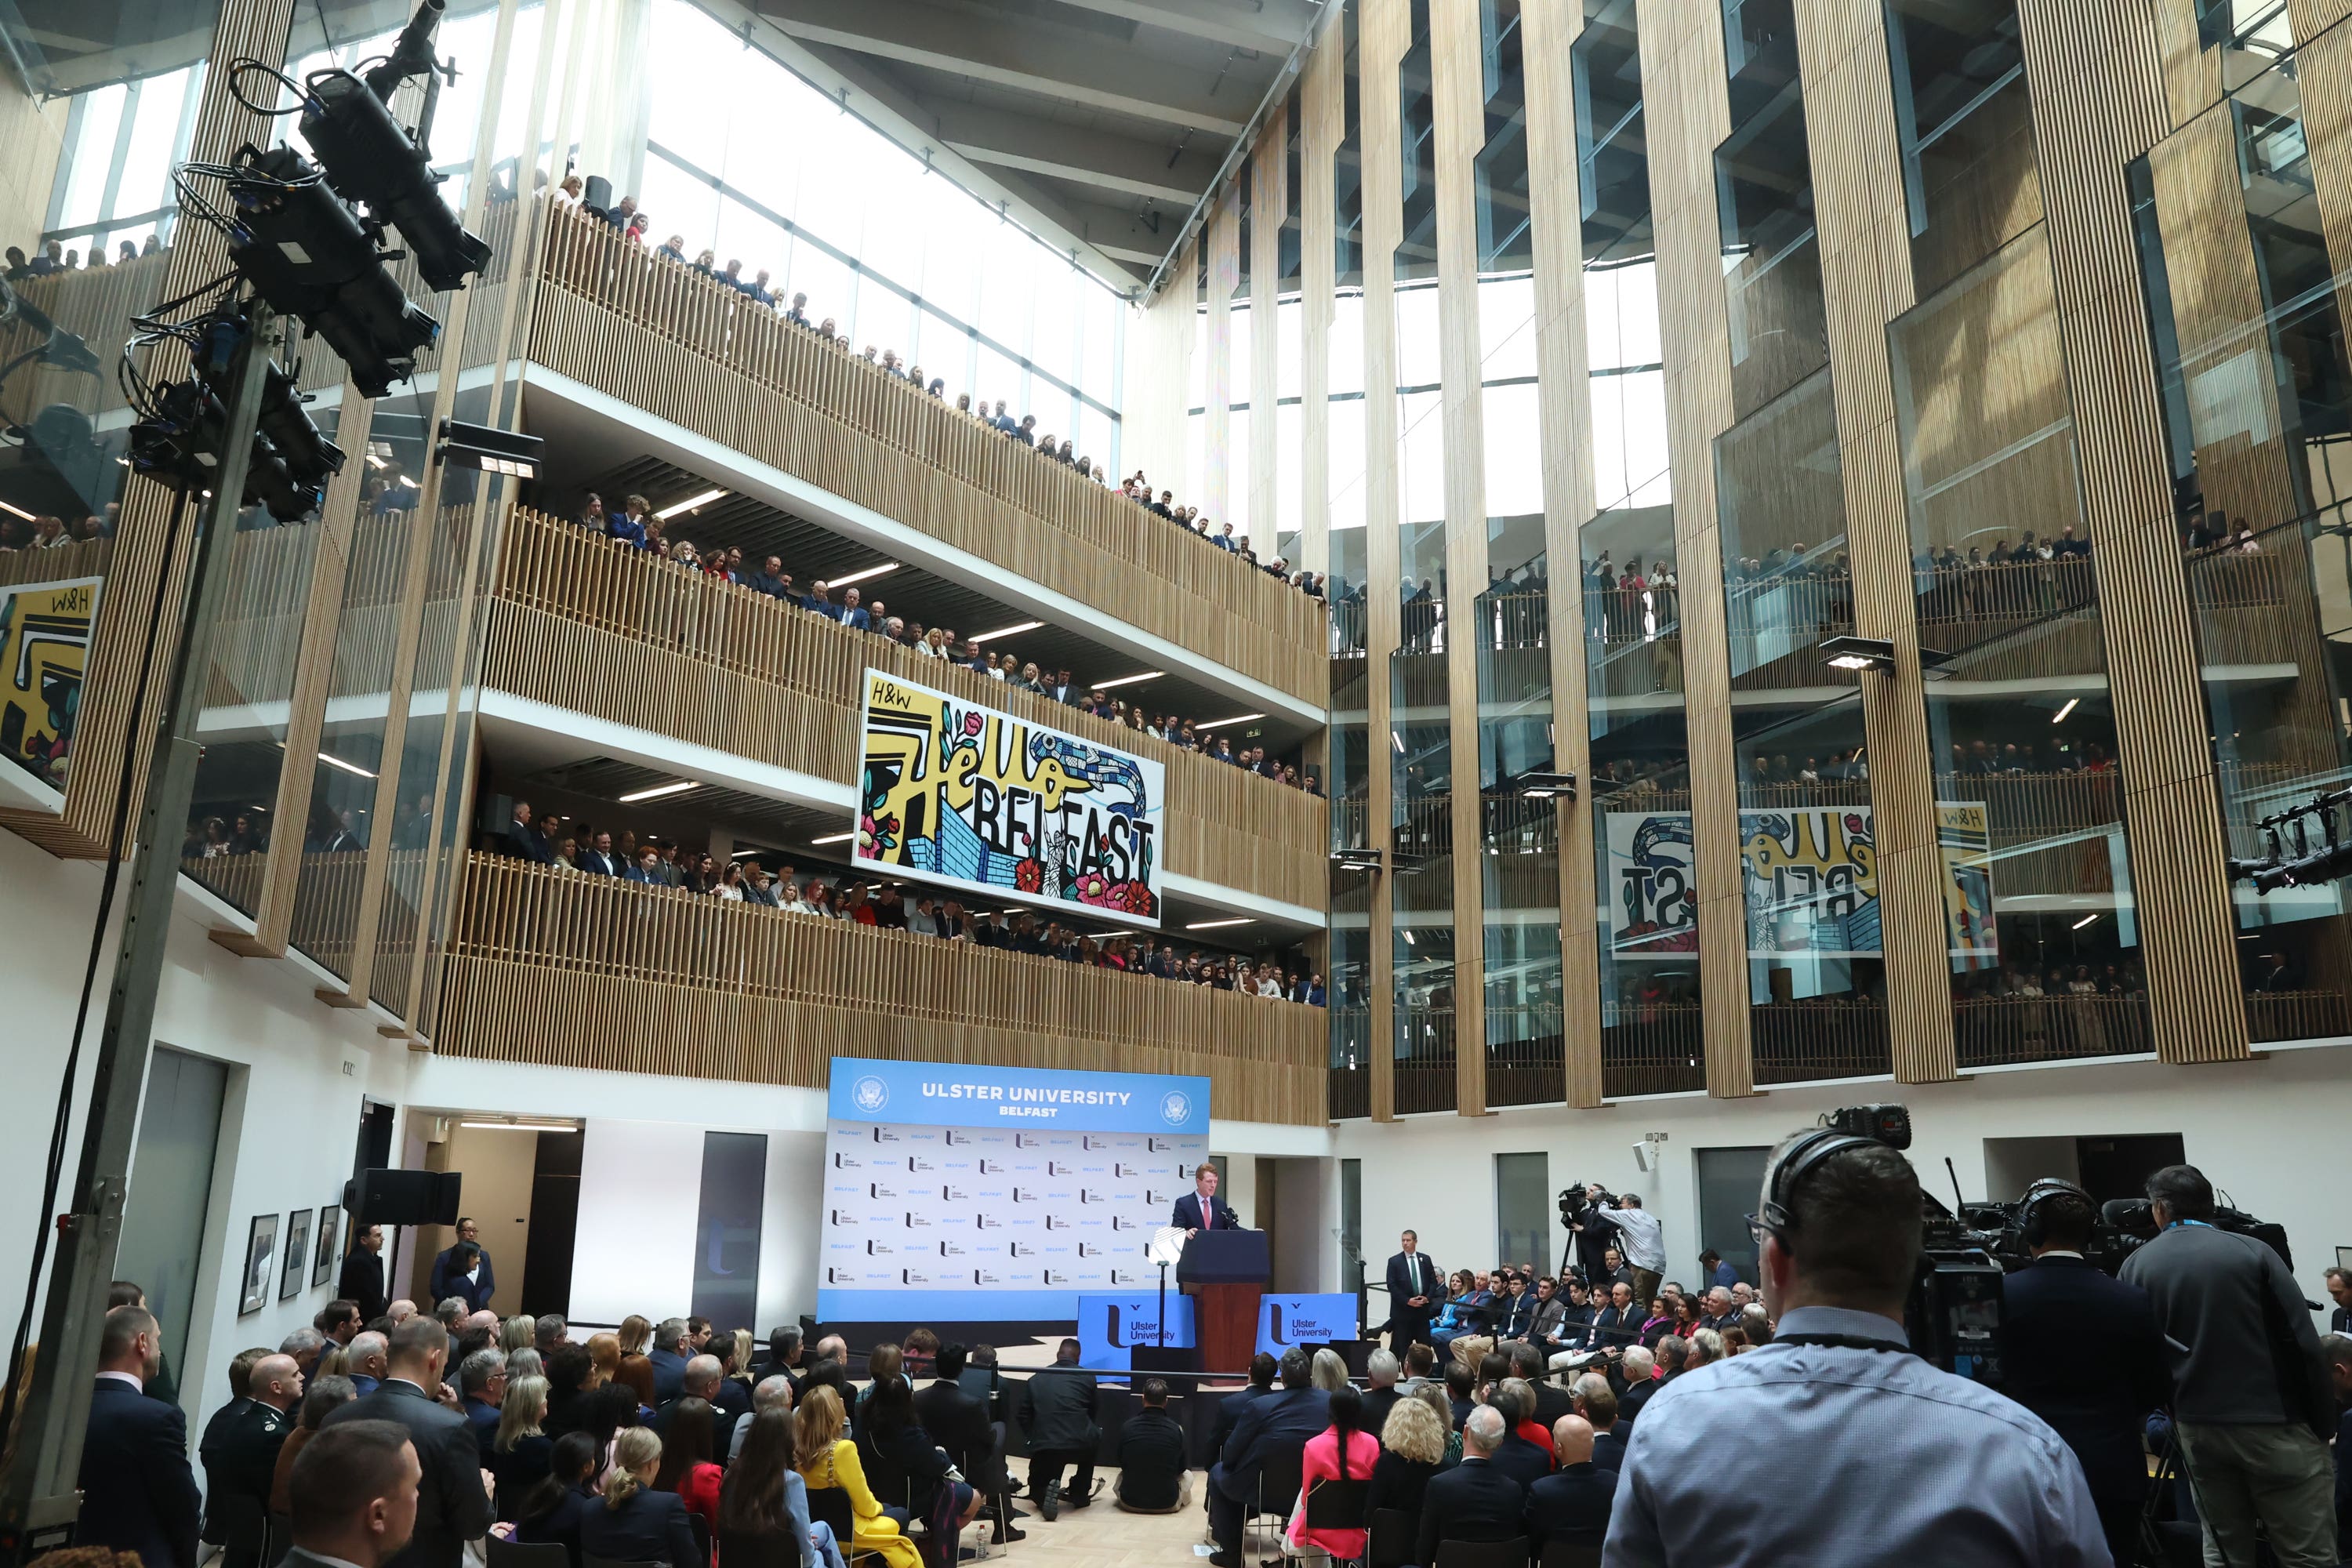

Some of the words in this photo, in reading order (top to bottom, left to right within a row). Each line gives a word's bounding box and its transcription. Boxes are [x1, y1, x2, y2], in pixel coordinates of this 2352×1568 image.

[873, 681, 912, 710] H&W
[866, 700, 1094, 864] Hello
[974, 776, 1153, 887] BELFAST
[922, 1083, 1004, 1100] ULSTER
[1009, 1087, 1131, 1106] UNIVERSITY
[999, 1105, 1058, 1118] BELFAST
[1131, 1321, 1158, 1330] Ulster
[1292, 1319, 1317, 1328] Ulster
[1131, 1330, 1175, 1341] Univerity
[1292, 1327, 1333, 1338] University
